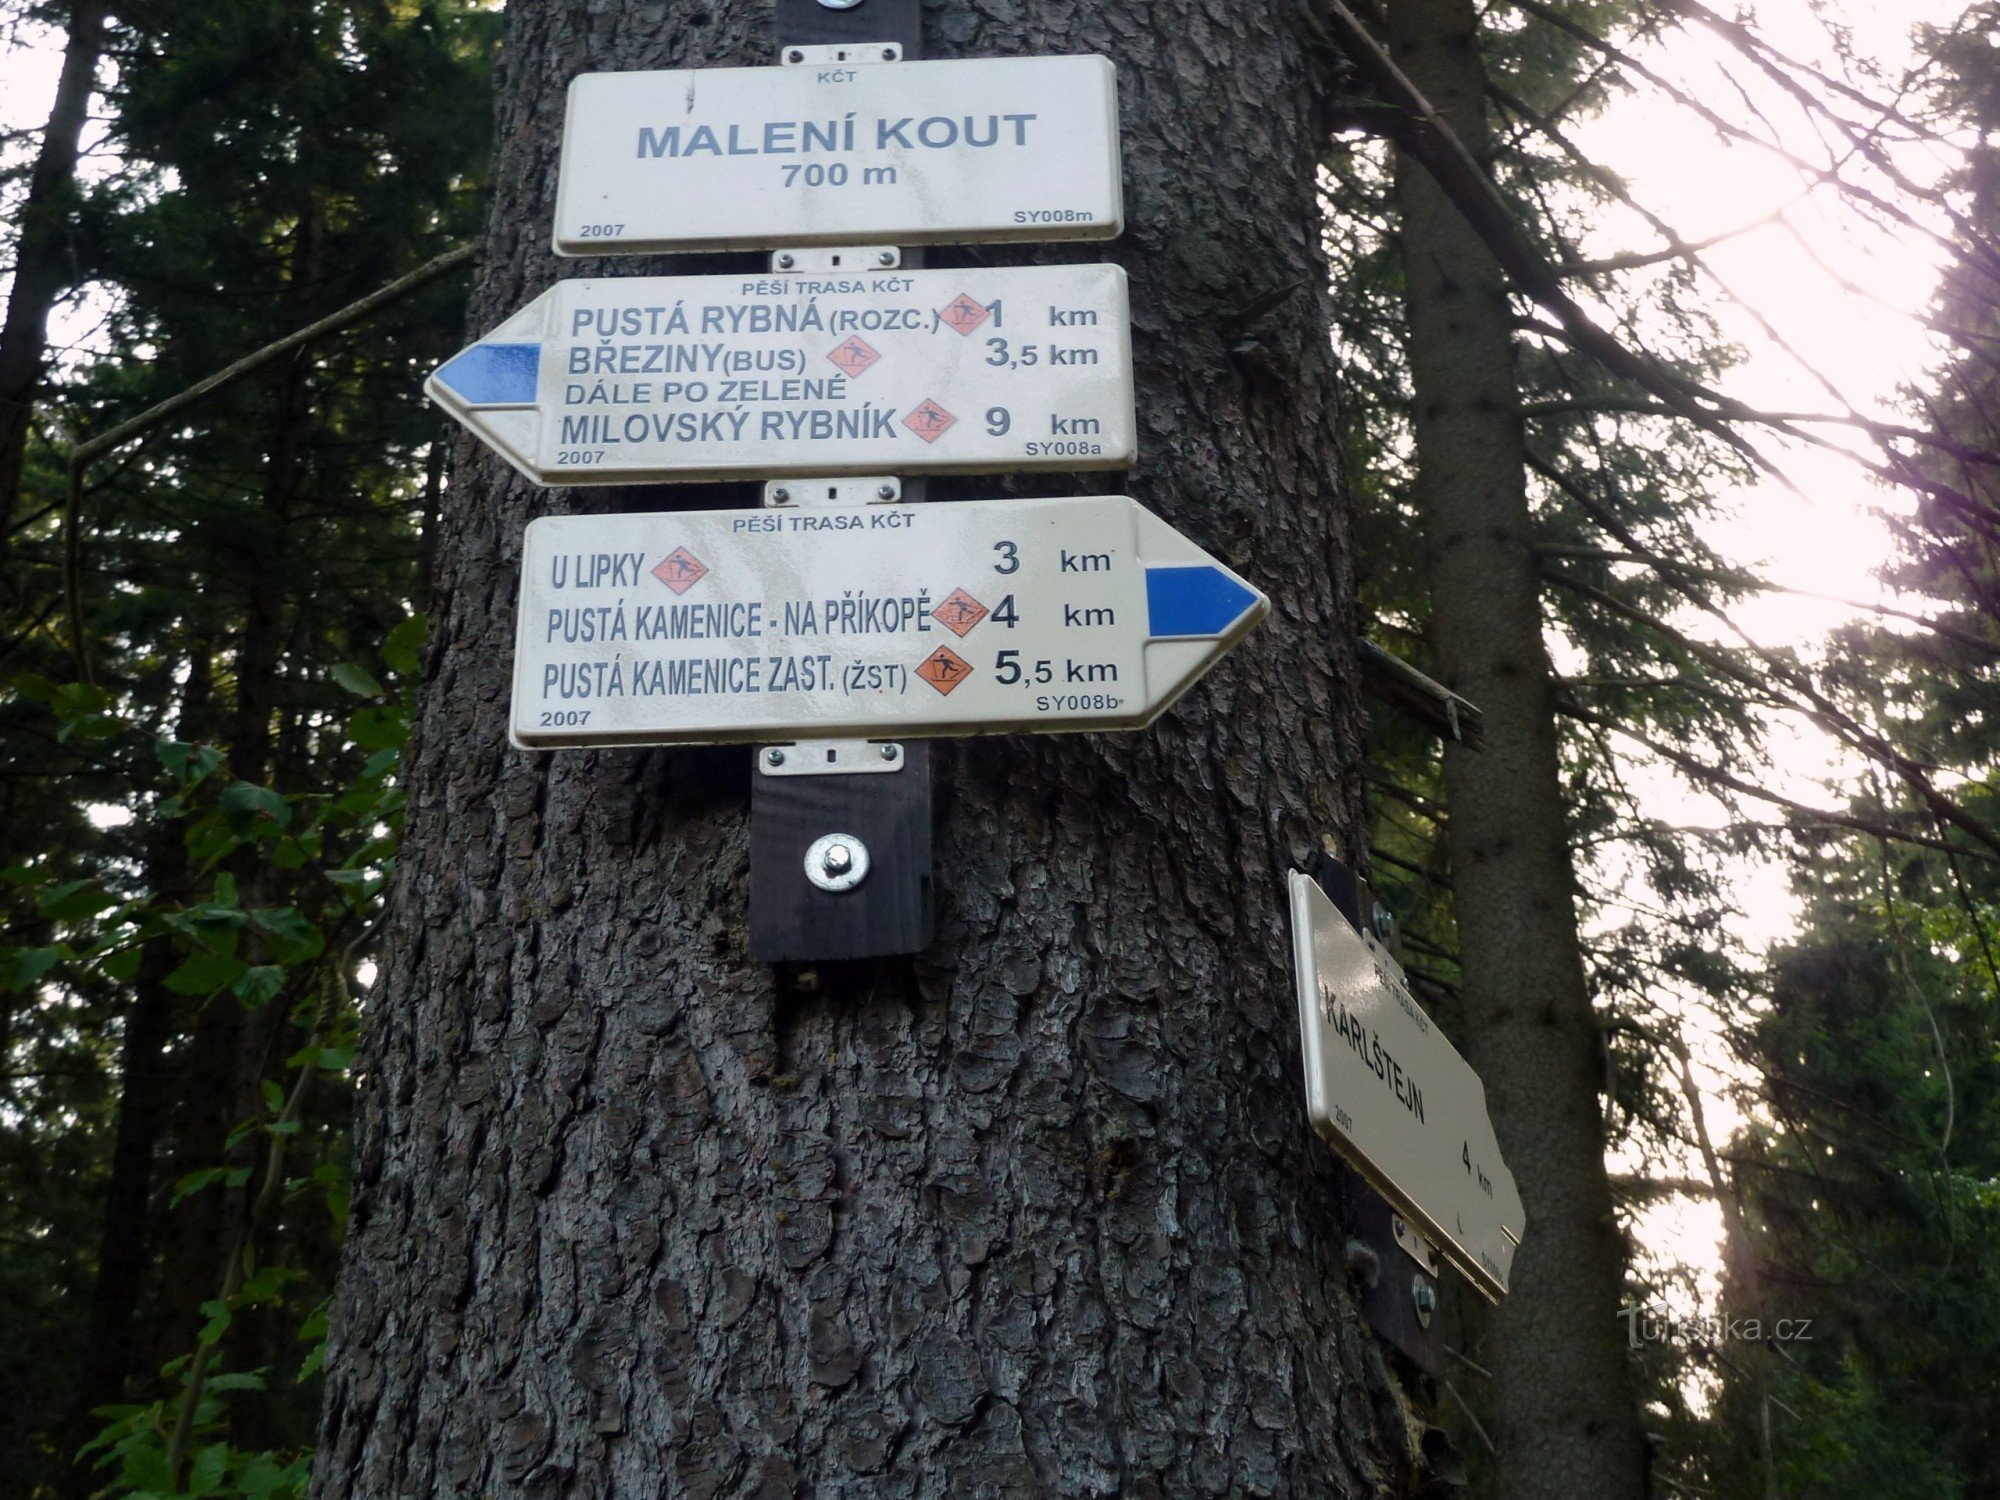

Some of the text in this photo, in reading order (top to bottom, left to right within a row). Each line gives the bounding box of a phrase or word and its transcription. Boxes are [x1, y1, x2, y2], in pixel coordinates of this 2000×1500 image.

[817, 68, 858, 84] KČT
[636, 112, 1037, 159] MALENÍ KOUT
[780, 162, 898, 188] 700 m
[1014, 208, 1093, 224] SY008m
[580, 224, 626, 239] 2007
[742, 277, 914, 296] PĚŠÍ TRASA KČT
[572, 300, 690, 337] PUSTÁ
[986, 299, 1002, 328] 1
[1050, 305, 1097, 327] km
[985, 337, 1038, 370] 3,5
[1050, 344, 1098, 365] km
[565, 373, 846, 405] DÁLE PO ZELENÉ
[561, 402, 1100, 445] MILOVSKÝ RYBNÍK 9 km
[557, 451, 605, 465] 2007
[1025, 442, 1102, 456] SY008a
[733, 511, 915, 533] PĚŠÍ TRASA KČT
[552, 541, 1111, 589] U LIPKY 3 km
[547, 599, 627, 643] PUSTÁ
[635, 602, 762, 641] KAMENICE
[785, 601, 818, 636] NA
[825, 588, 931, 635] PŘÍKOPĚ
[991, 594, 1020, 629] 4
[1064, 604, 1115, 627] km
[543, 650, 1118, 699] PUSTÁ KAMENICE ZAST. (ŽST) 5,5 km
[1036, 694, 1119, 711] SY008b
[540, 711, 592, 727] 2007
[1322, 985, 1493, 1199] KARLŠTEJN 4 km
[1335, 1104, 1352, 1133] 2007
